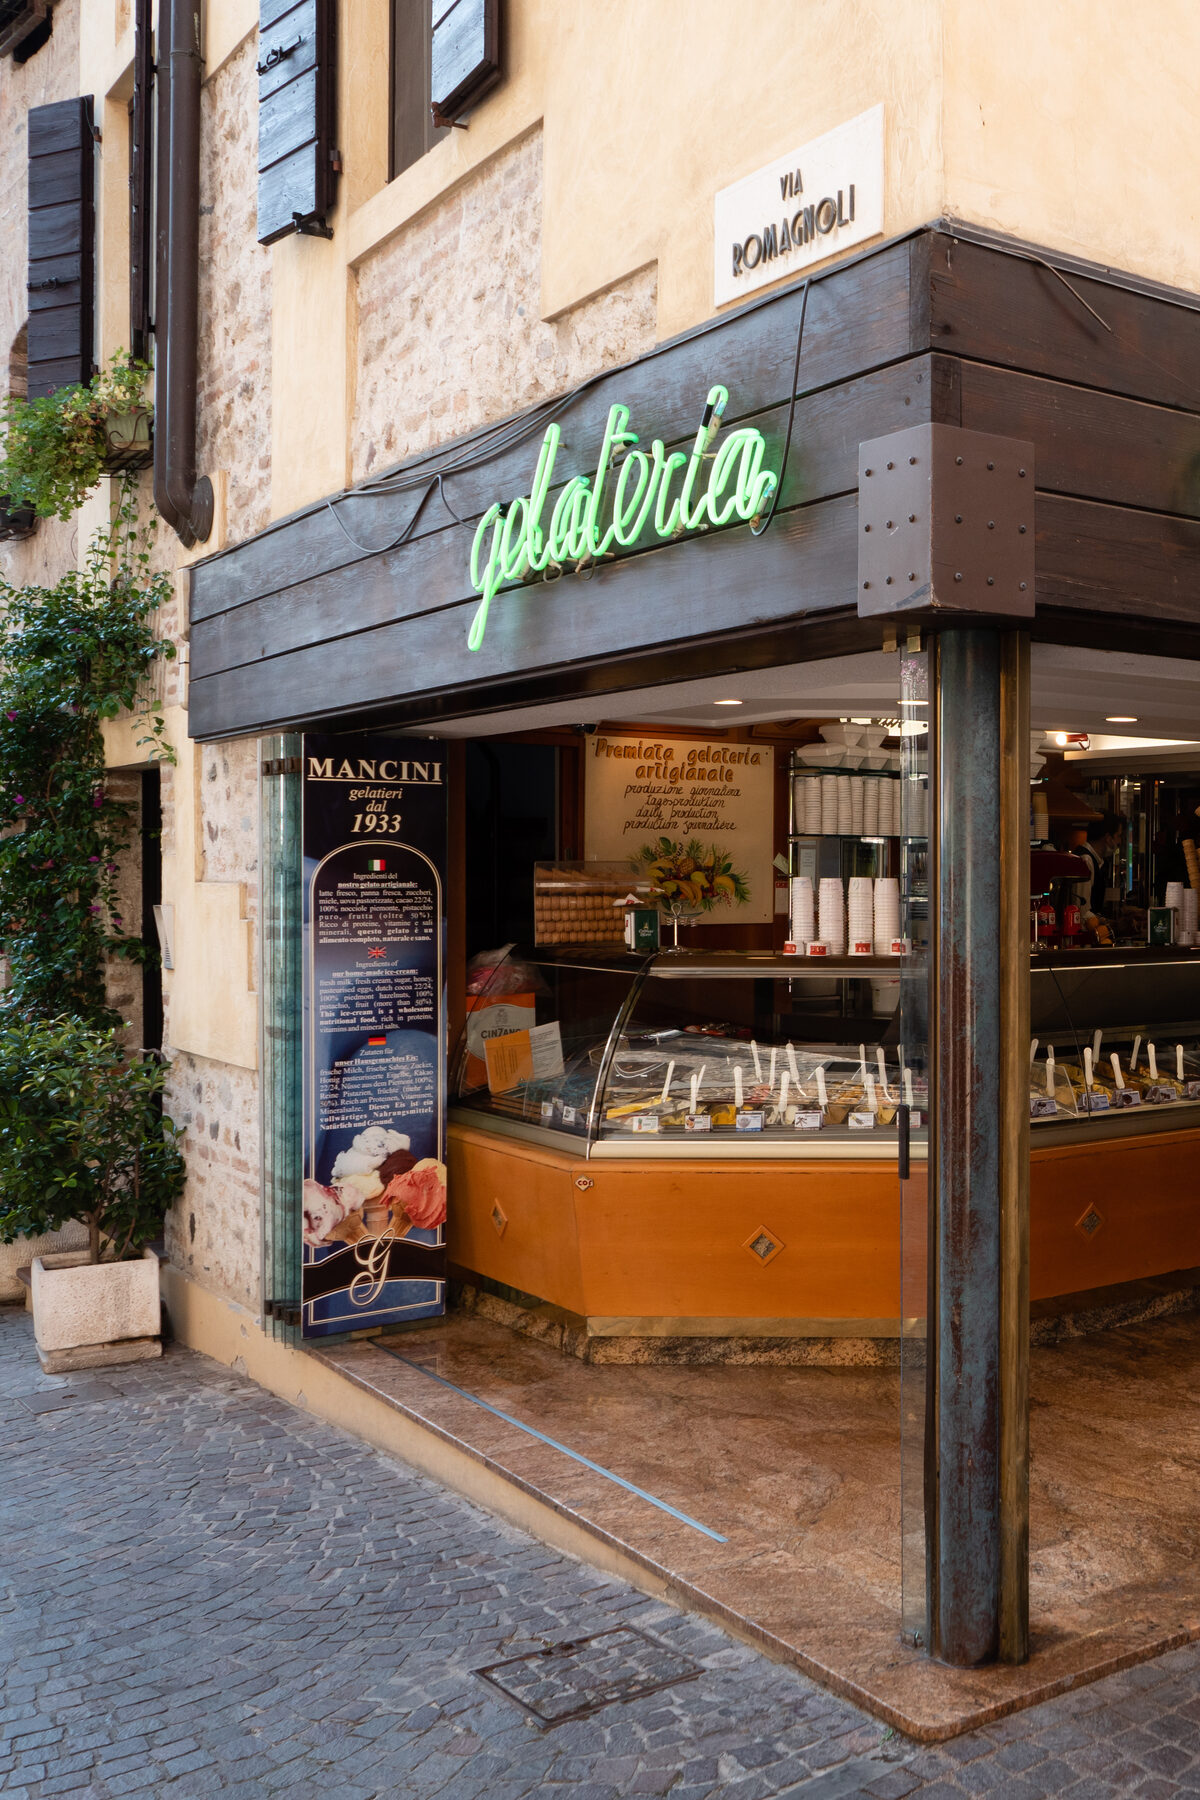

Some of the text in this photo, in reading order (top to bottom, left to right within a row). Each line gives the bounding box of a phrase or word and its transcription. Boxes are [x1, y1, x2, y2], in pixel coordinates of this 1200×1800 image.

[780, 169, 803, 201] VIA
[733, 184, 855, 277] ROMAGNOLI
[468, 385, 777, 651] gelateria
[595, 738, 761, 766] Premiata gelateria
[308, 757, 442, 781] MANCINI
[635, 761, 734, 785] artigianale
[349, 787, 403, 801] gelatieri
[624, 782, 683, 798] produzione
[366, 801, 387, 812] dal
[636, 806, 718, 820] daily production
[351, 814, 401, 833] 1933
[623, 819, 679, 835] production
